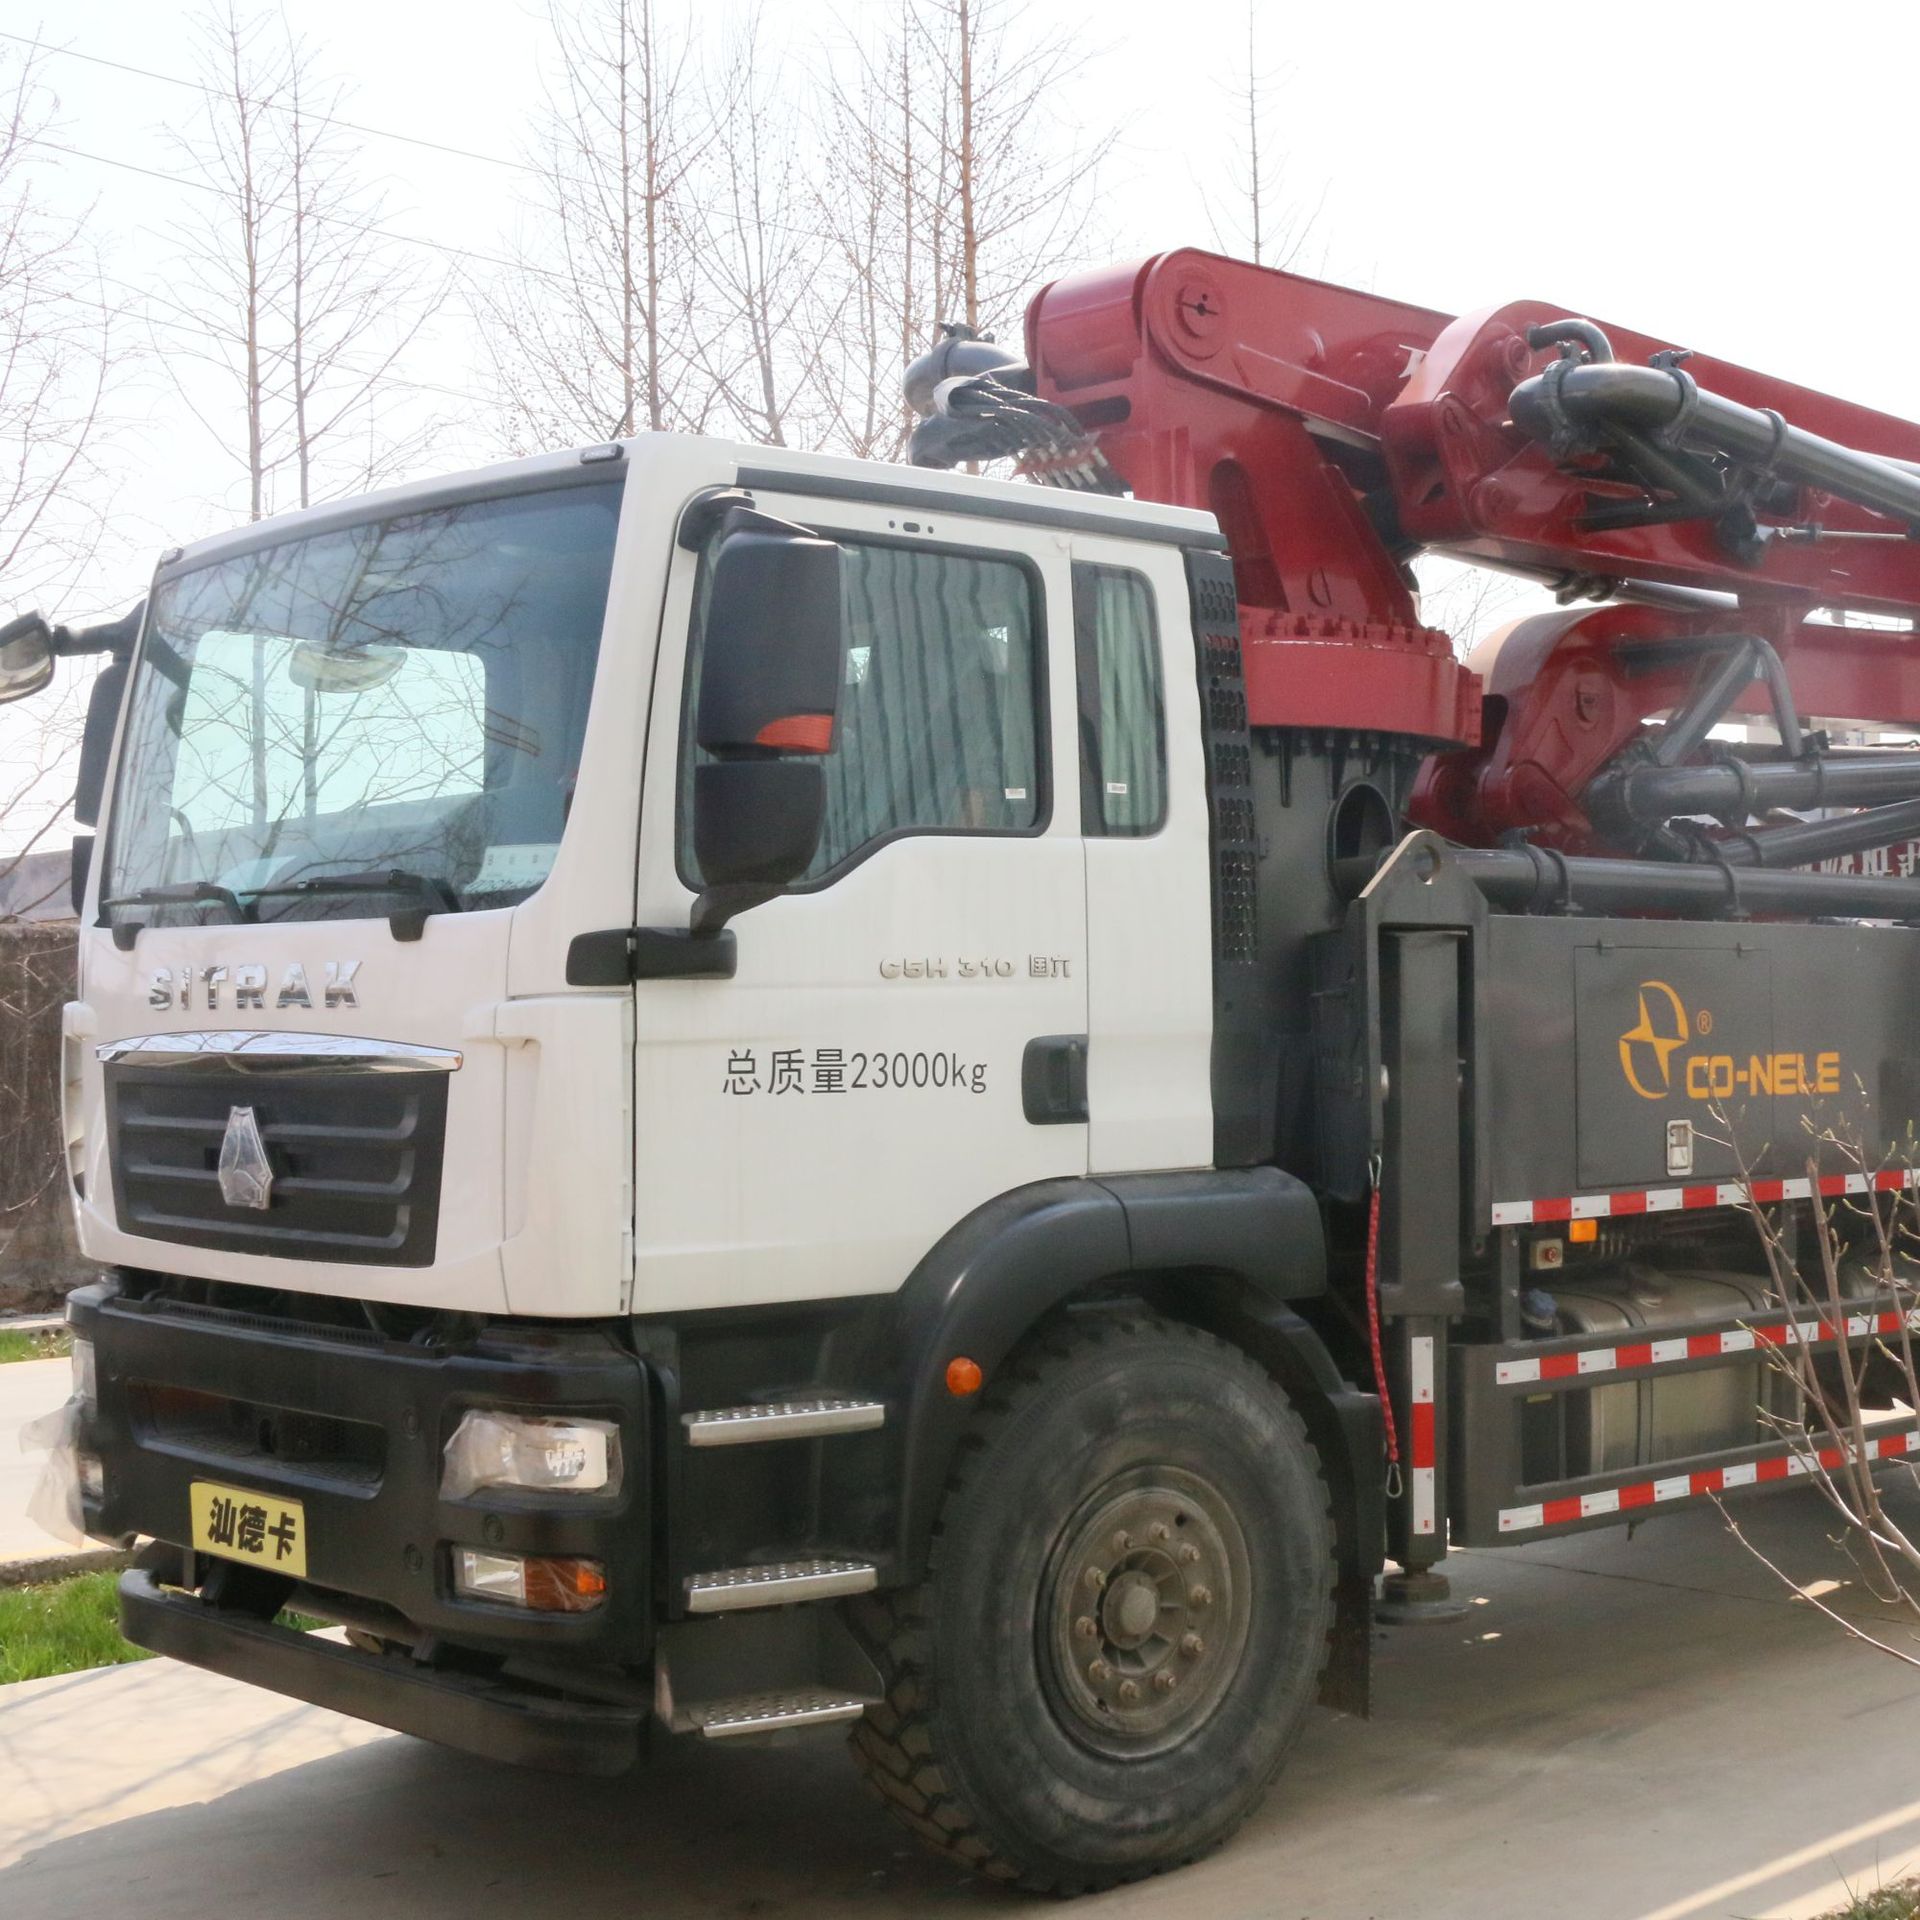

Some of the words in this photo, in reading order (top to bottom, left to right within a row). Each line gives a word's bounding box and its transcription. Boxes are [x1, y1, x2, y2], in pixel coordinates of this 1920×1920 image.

[148, 959, 363, 1012] SITRAK
[958, 955, 1016, 979] 310
[722, 1047, 988, 1095] 总质量23000kg
[1686, 1051, 1841, 1100] CO-NELE
[207, 1495, 297, 1561] 汕德卡
